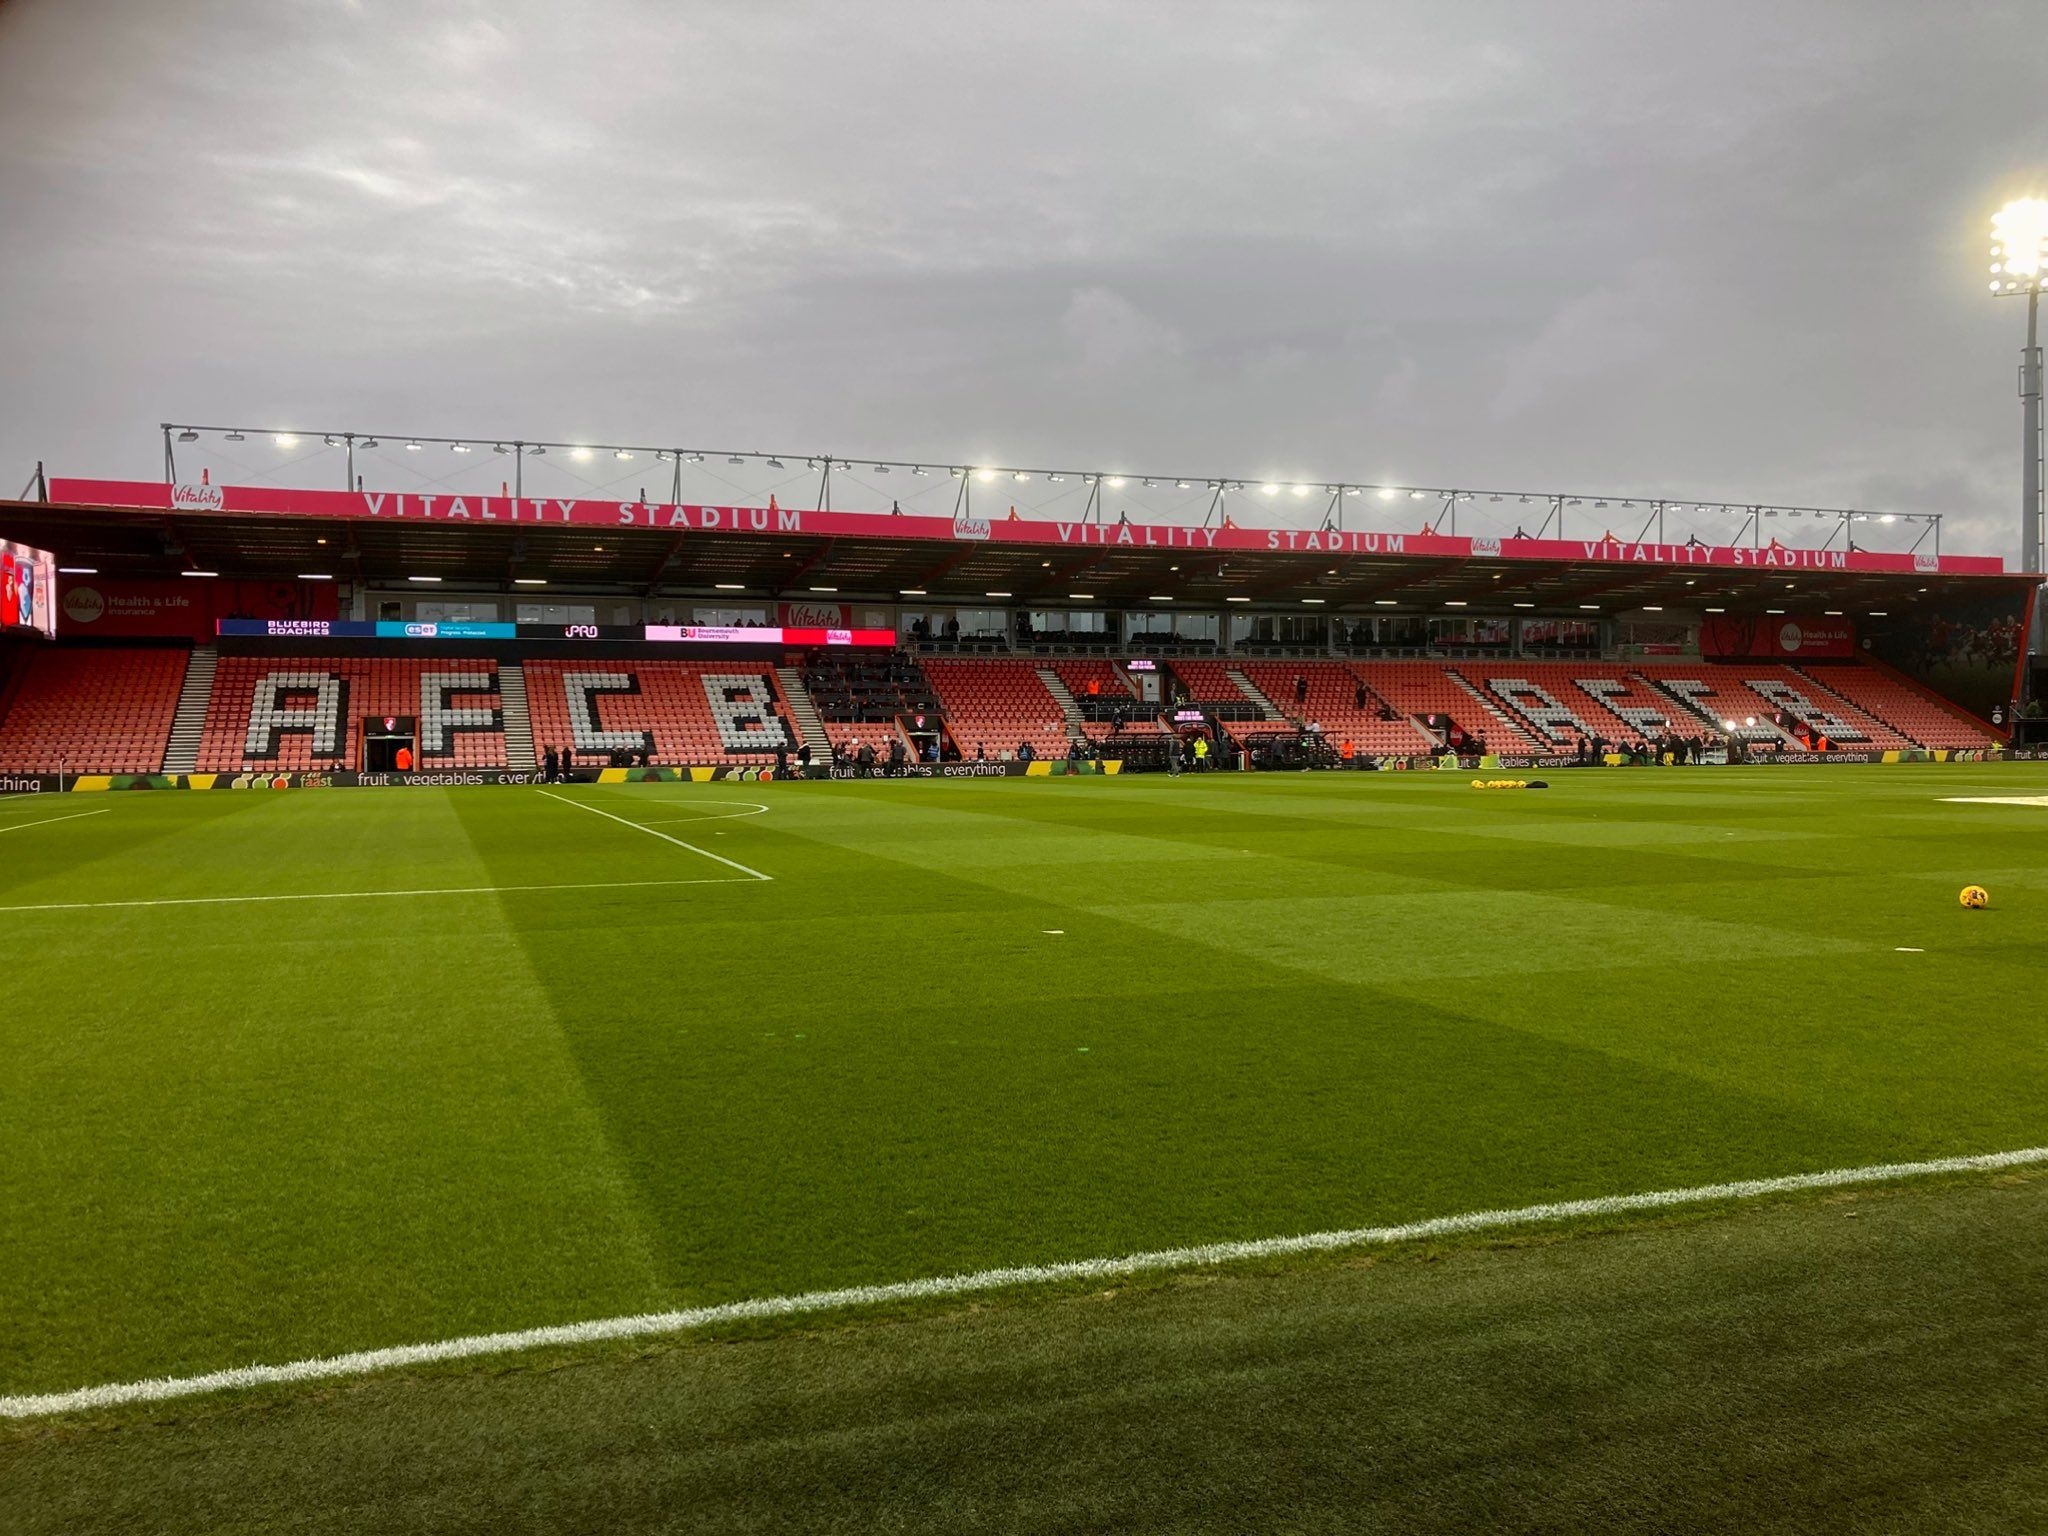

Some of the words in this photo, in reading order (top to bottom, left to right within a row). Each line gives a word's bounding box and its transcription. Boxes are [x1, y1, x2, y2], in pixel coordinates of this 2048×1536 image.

[174, 485, 220, 508] Vitality
[364, 493, 576, 522] VITALITY
[618, 502, 801, 532] STADIUM
[955, 519, 989, 539] Vitality
[1057, 523, 1218, 548] VITALITY
[1267, 530, 1405, 553] STADIUM
[1583, 542, 1715, 565] VITALITY
[1734, 549, 1847, 569] STADIUM
[108, 595, 151, 607] Health
[153, 598, 161, 607] &
[165, 595, 190, 607] Life
[267, 620, 330, 628] BLUEBIRD
[790, 605, 840, 628] Vitality
[268, 628, 330, 636] COACHES
[680, 628, 697, 638] BU
[1826, 753, 1868, 763] everything
[2015, 750, 2032, 759] fruit
[830, 766, 855, 779] fruit
[944, 763, 1006, 778] everything
[0, 776, 41, 792] hing
[358, 772, 390, 787] fruit
[403, 773, 483, 787] vegetables
